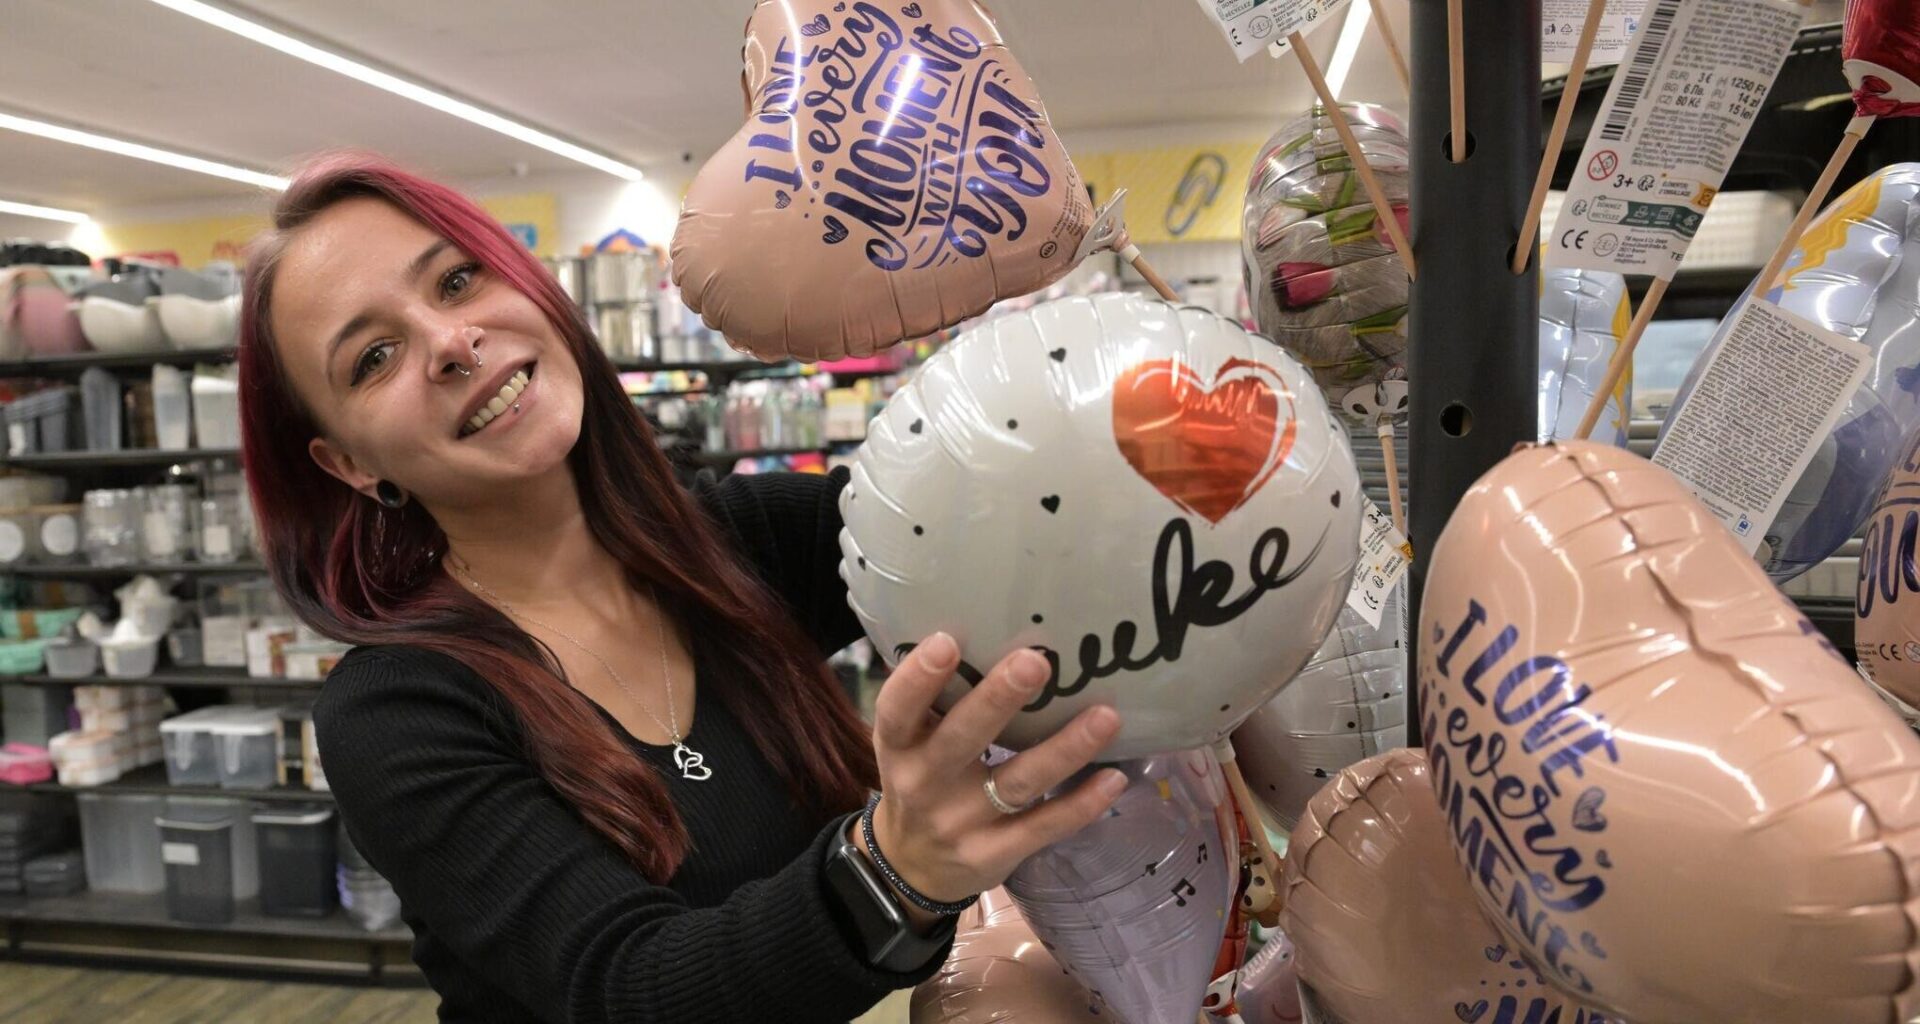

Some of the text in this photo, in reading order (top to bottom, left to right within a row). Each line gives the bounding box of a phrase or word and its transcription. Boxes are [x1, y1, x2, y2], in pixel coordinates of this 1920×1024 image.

[810, 1, 904, 154] every
[1731, 77, 1754, 91] 1250
[1754, 83, 1767, 96] Ft
[1683, 83, 1690, 94] 6
[1738, 93, 1749, 104] 14
[745, 37, 821, 191] I LOVE
[1728, 103, 1740, 115] 15
[1740, 106, 1753, 119] lei
[917, 122, 961, 227] WITH
[1613, 174, 1634, 188] 3+
[1561, 229, 1589, 249] CE
[1367, 510, 1384, 524] 3+
[1879, 643, 1903, 661] CE
[1436, 599, 1621, 797] I LOVE
[1446, 707, 1606, 913] every
